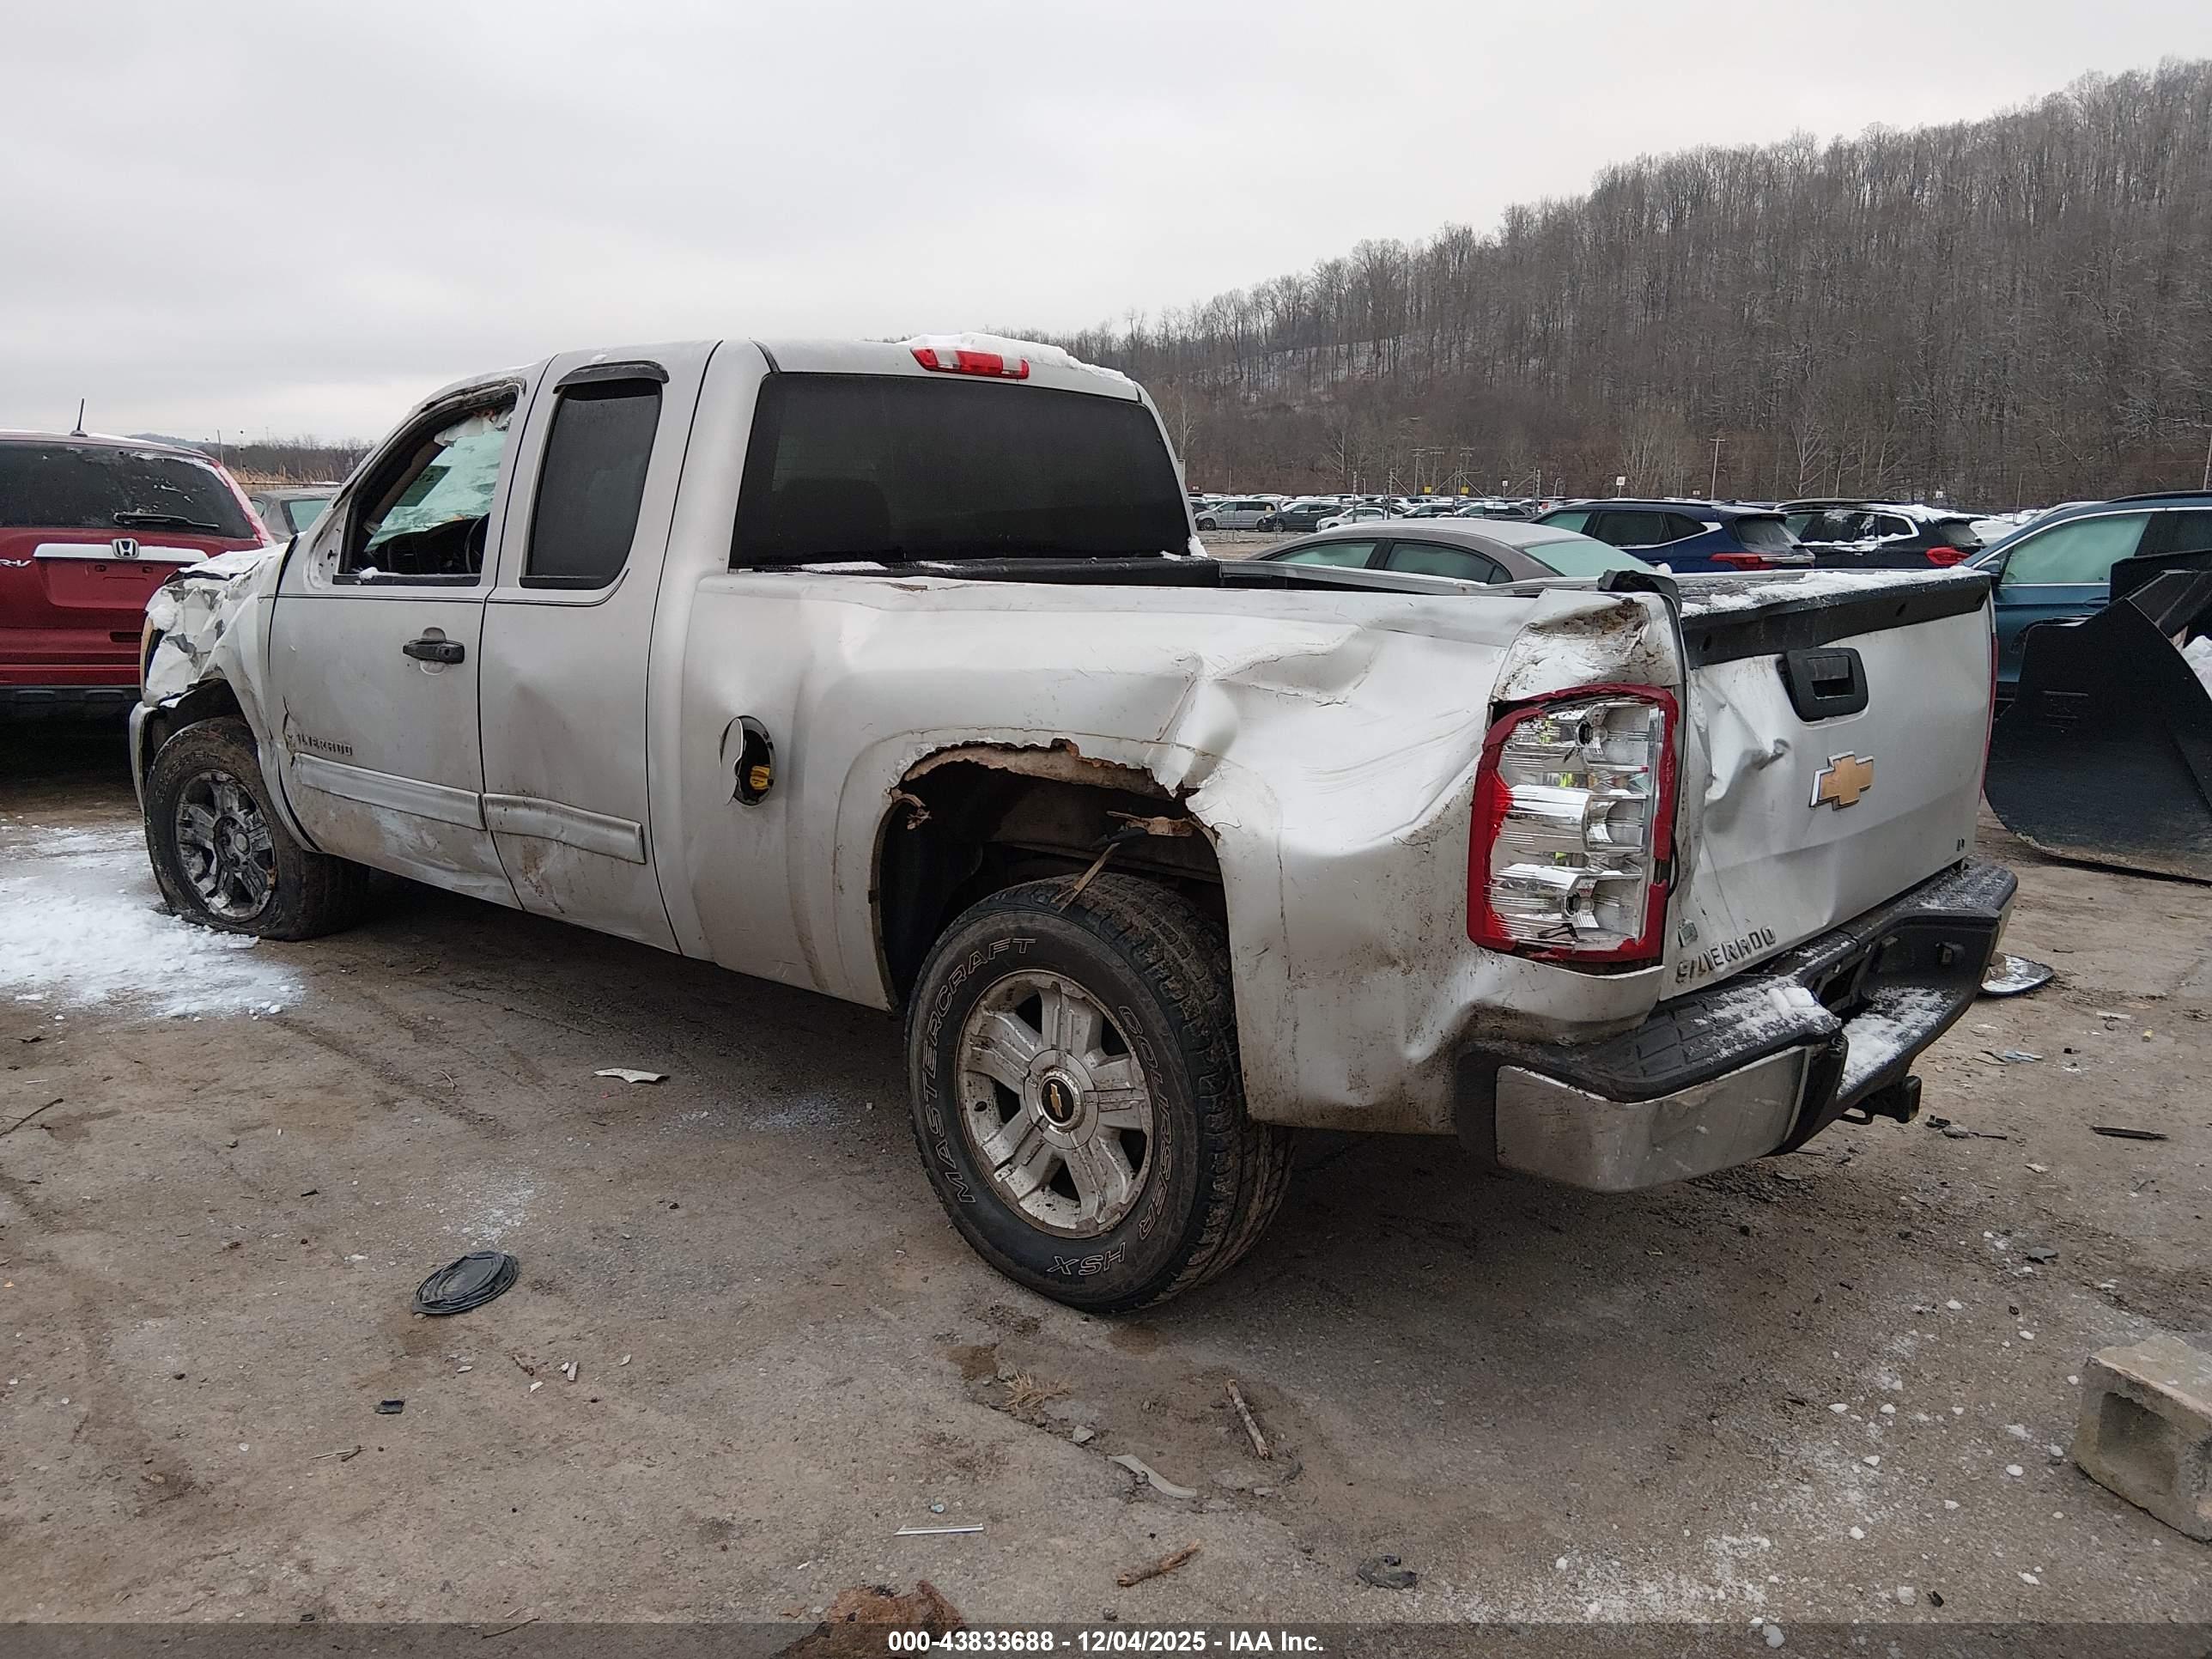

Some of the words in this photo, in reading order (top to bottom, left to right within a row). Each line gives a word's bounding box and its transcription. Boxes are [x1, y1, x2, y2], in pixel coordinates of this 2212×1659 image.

[0, 558, 33, 568] R-V
[921, 938, 1037, 1203] MASTERCRAFT
[1118, 1005, 1173, 1242] COURSER
[1045, 1242, 1127, 1277] HSX
